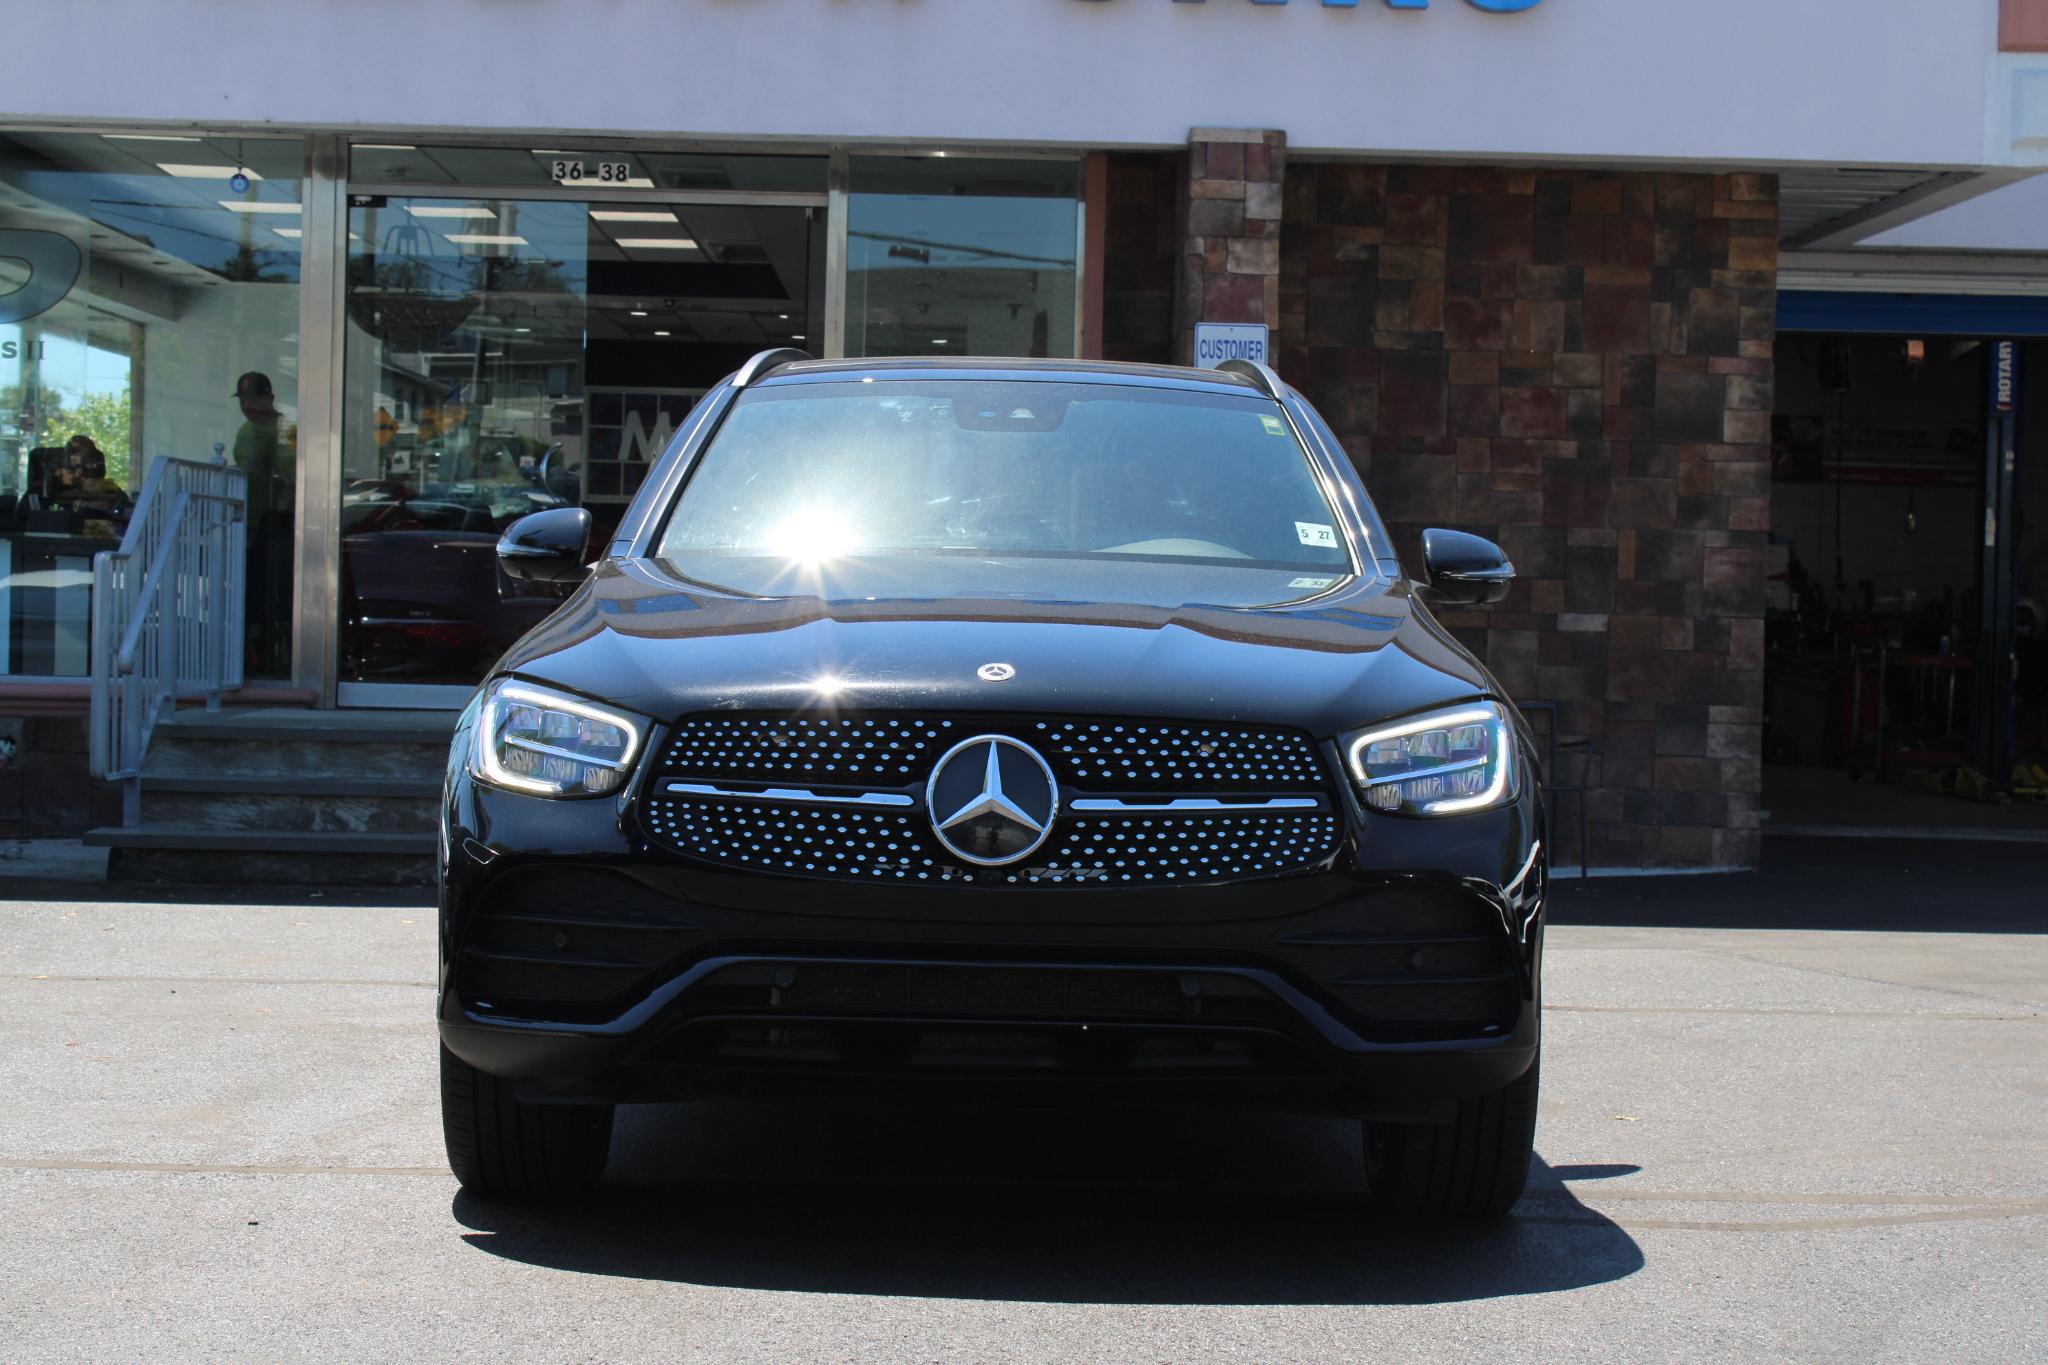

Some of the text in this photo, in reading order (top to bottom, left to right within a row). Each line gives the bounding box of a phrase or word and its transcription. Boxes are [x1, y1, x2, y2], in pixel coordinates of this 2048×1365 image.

[554, 161, 627, 182] 36-38
[1199, 339, 1264, 361] CUSTOMER
[1301, 528, 1331, 540] 5 27
